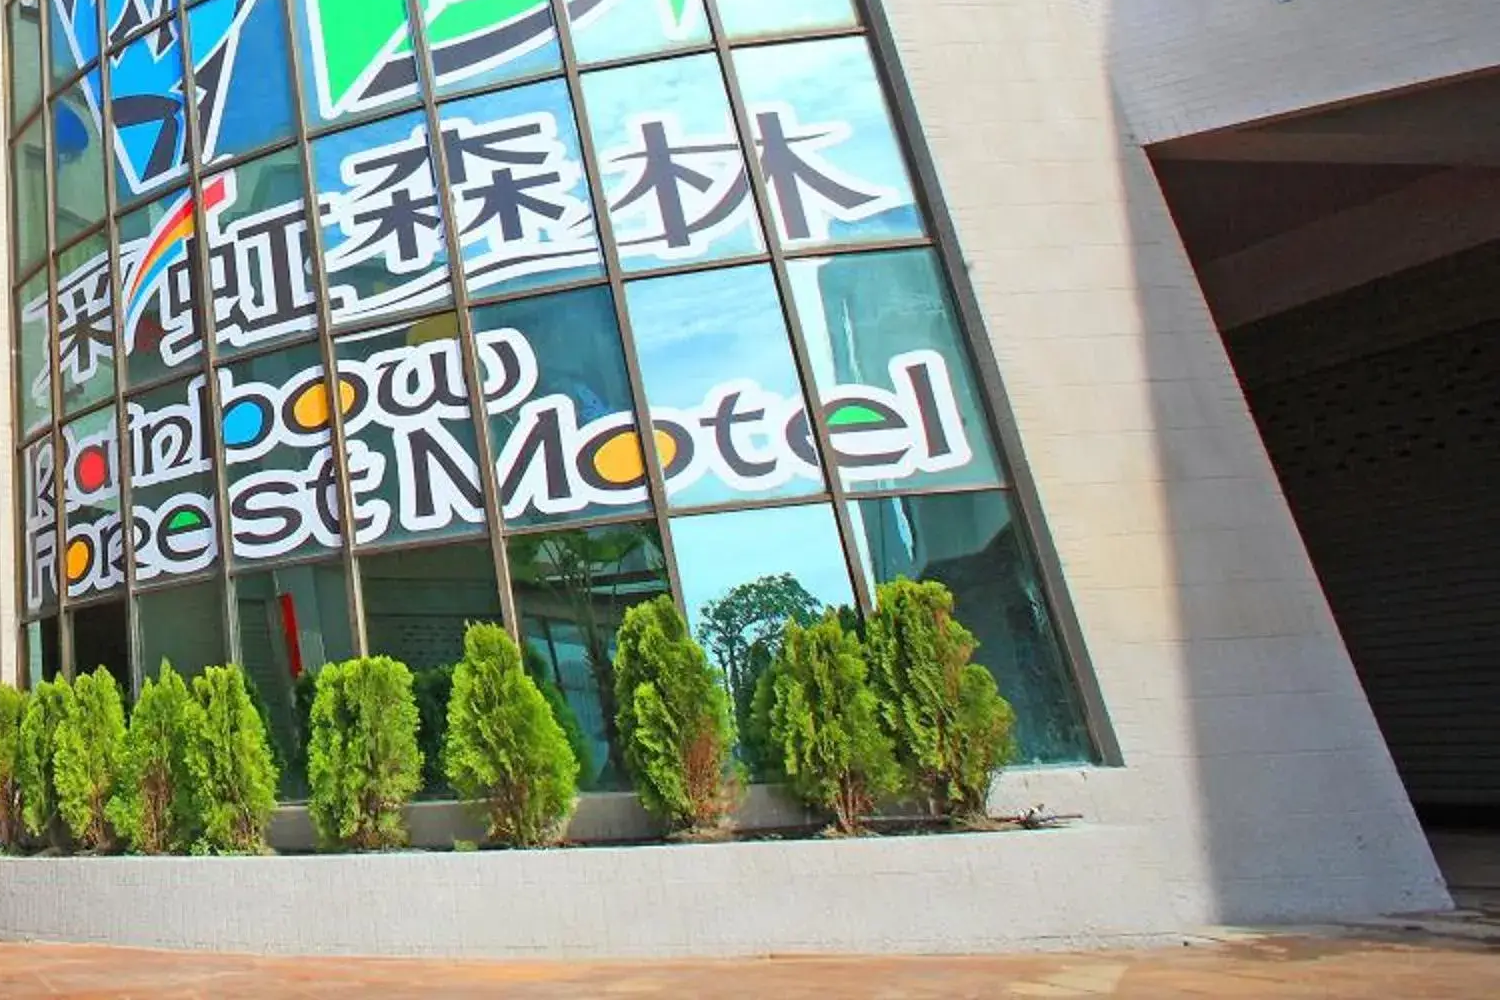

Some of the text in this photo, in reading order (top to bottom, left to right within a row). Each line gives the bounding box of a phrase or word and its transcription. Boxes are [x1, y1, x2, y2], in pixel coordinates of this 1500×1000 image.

[32, 106, 885, 384] 彩虹森林
[28, 342, 528, 520] Rainbow
[400, 360, 960, 522] Motel
